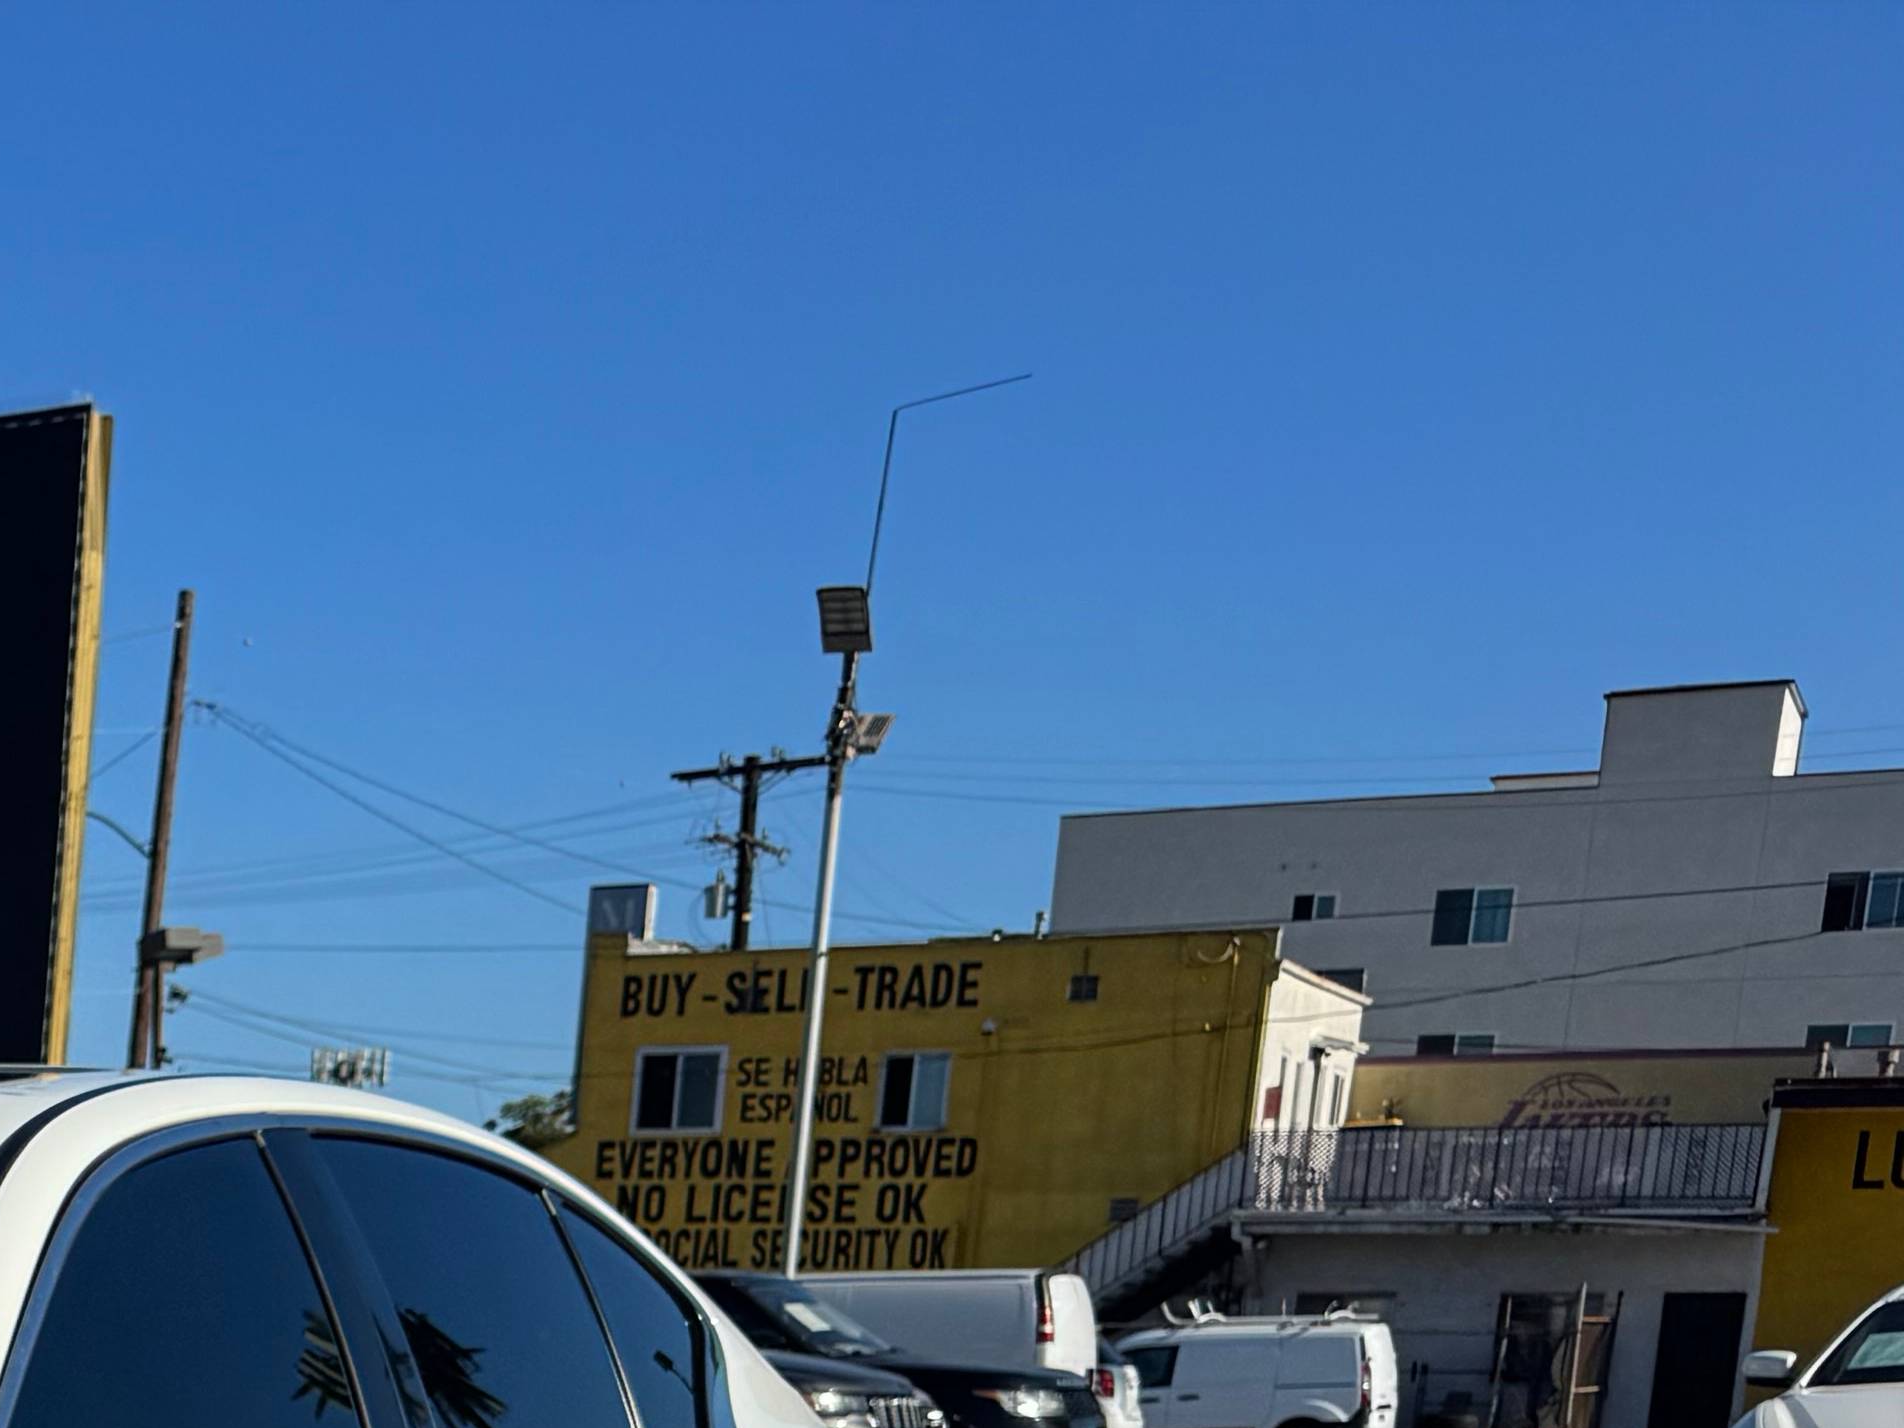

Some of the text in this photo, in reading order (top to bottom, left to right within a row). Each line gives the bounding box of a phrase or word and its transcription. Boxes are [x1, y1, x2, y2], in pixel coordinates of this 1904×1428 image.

[735, 1055, 869, 1087] SE HBLA
[740, 1092, 859, 1123] ESPNOL
[595, 1137, 978, 1180] EVERYONE PPROVED
[617, 1184, 667, 1225] NO
[874, 1182, 929, 1224] OK
[644, 1228, 738, 1269] OCIAL
[909, 1228, 950, 1269] OK
